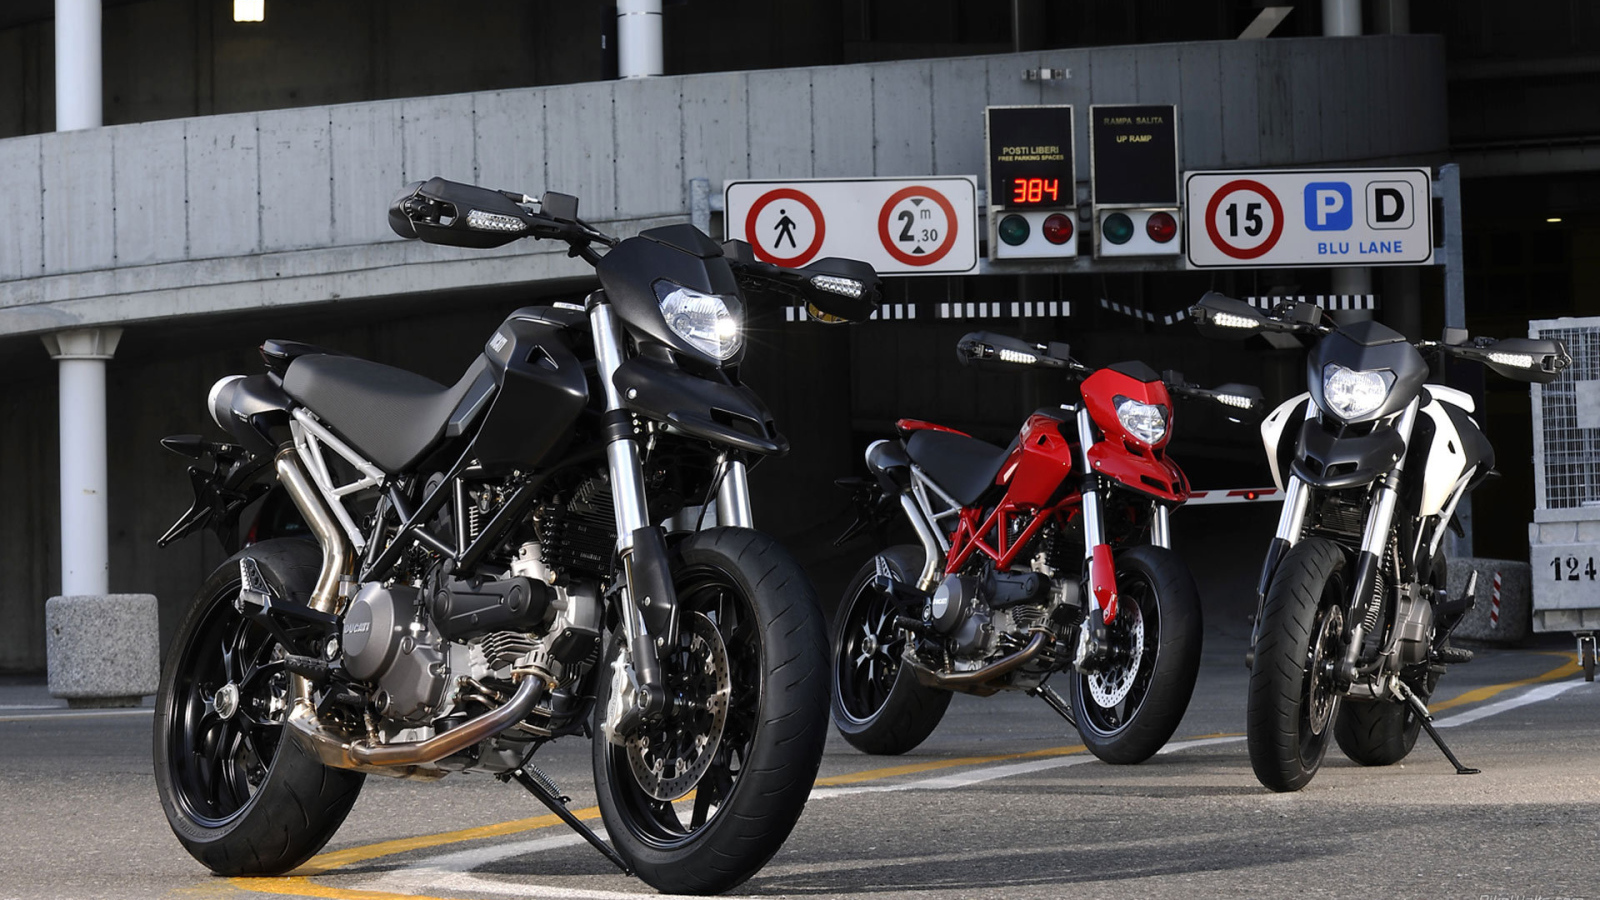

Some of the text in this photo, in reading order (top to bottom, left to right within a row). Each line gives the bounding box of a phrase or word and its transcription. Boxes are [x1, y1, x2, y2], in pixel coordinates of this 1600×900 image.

[1103, 116, 1164, 125] RAMPA SALITA
[1116, 134, 1153, 143] UP RAMP
[1003, 146, 1060, 155] POSTI LIBERI
[1013, 178, 1059, 202] 384
[1315, 189, 1345, 226] P
[1374, 187, 1405, 223] D
[920, 209, 931, 219] m
[1225, 202, 1264, 237] 15
[1317, 240, 1404, 255] BLU LANE
[1549, 556, 1597, 581] 124
[344, 622, 370, 634] DUCATI
